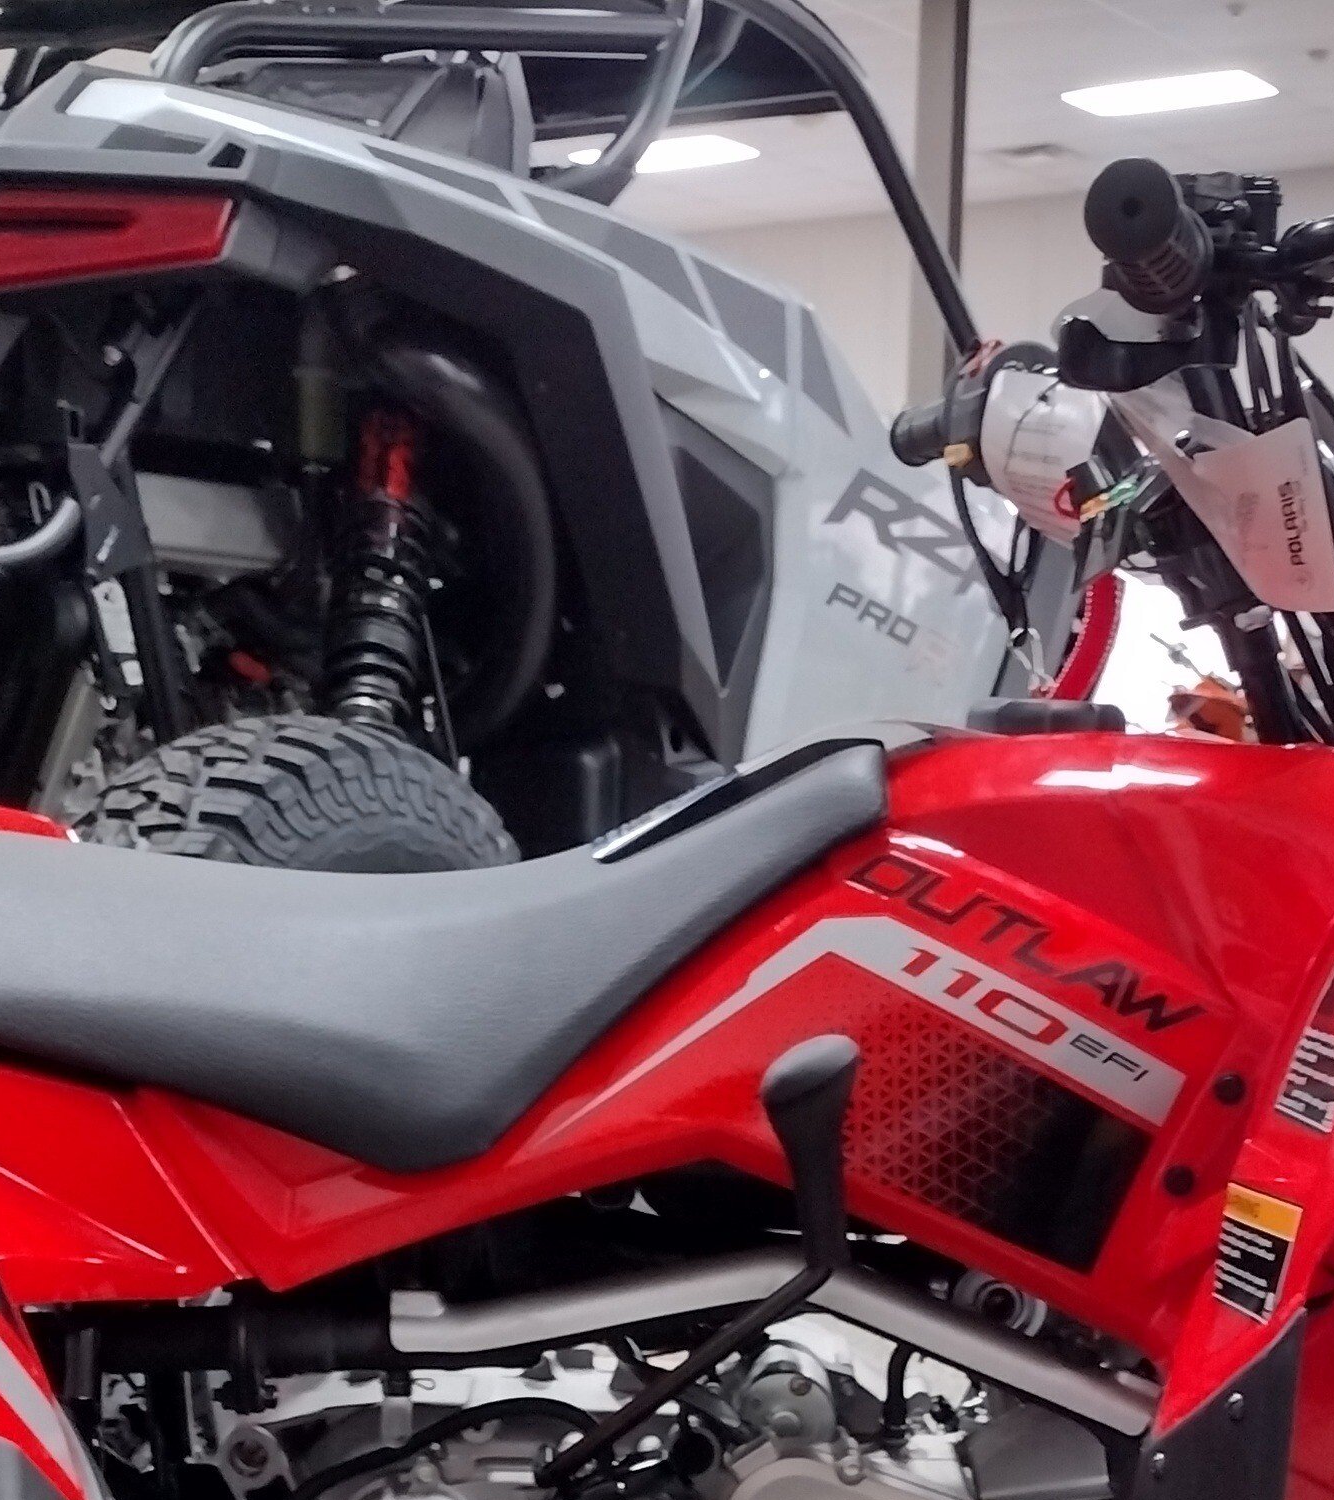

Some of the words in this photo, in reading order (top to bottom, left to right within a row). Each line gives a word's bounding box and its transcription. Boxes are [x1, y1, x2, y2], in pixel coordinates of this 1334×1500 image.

[1277, 480, 1306, 566] POLARIS
[825, 582, 919, 646] PRO
[846, 854, 1207, 1033] OUTLAW
[901, 947, 1069, 1045] 110
[1069, 1033, 1149, 1082] EFI
